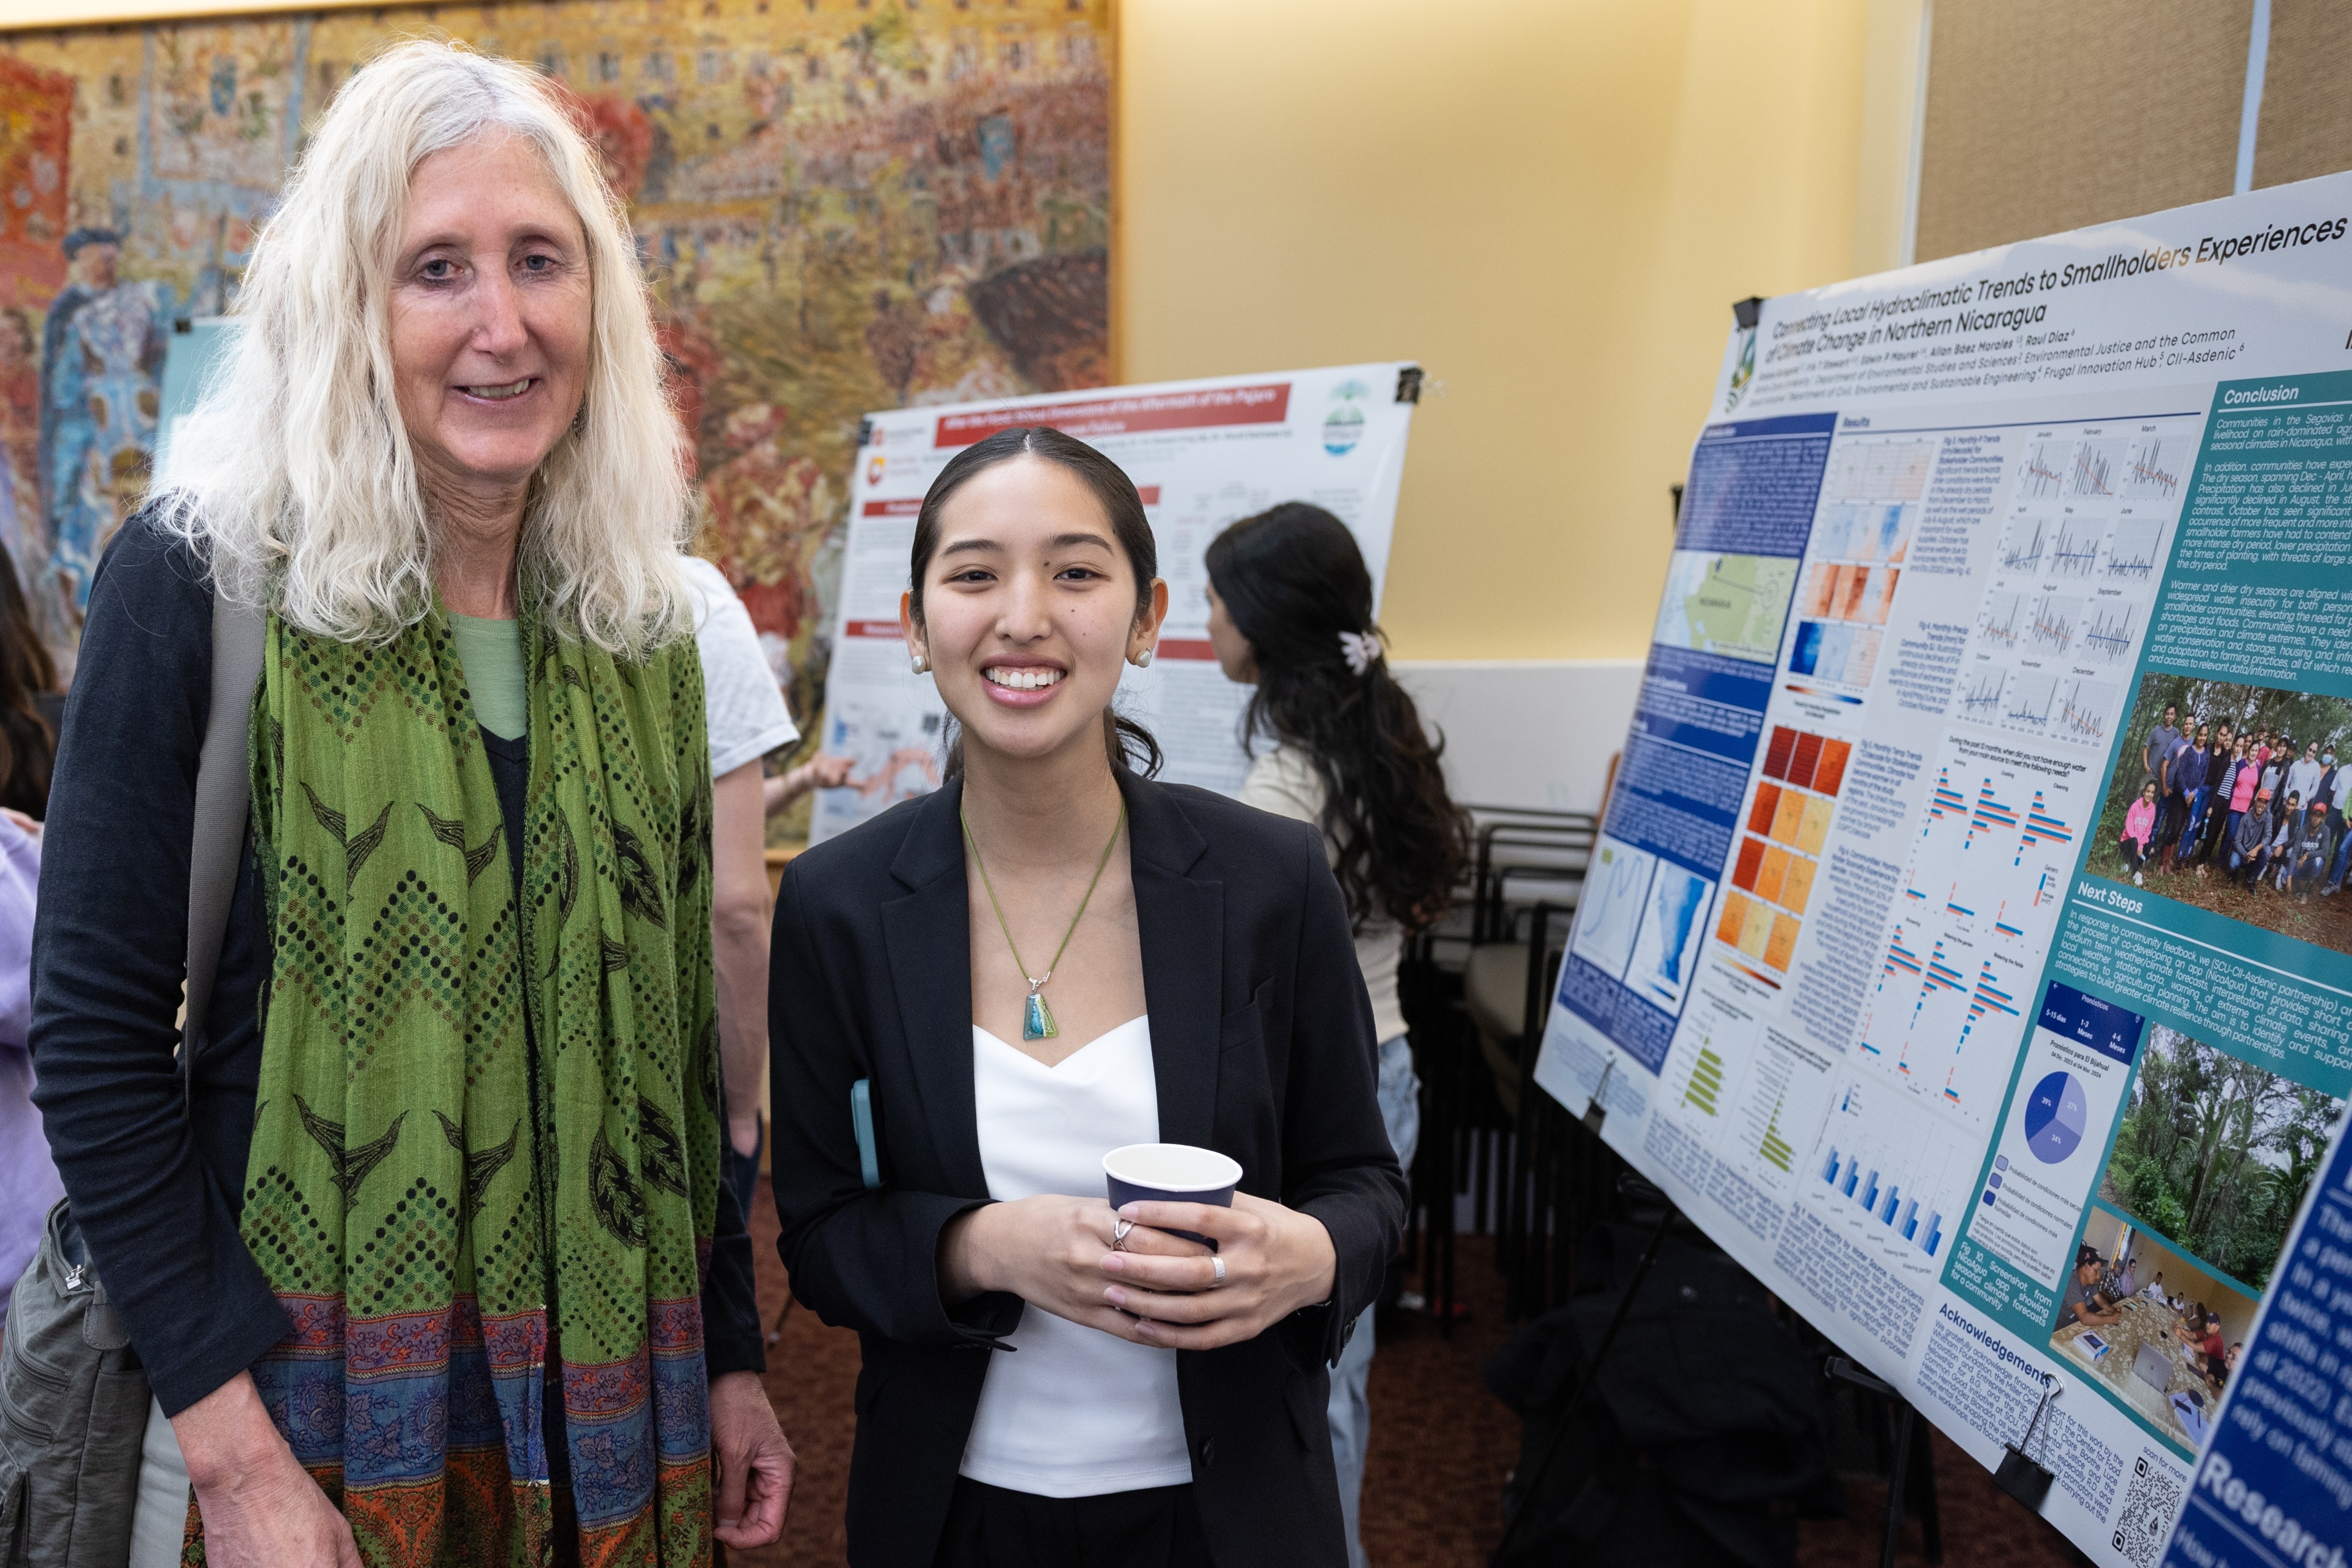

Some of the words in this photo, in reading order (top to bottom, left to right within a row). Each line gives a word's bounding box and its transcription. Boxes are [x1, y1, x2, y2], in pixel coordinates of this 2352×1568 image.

[1833, 302, 1869, 325] Local
[1870, 282, 1972, 316] Hydroclimatic
[1978, 271, 2034, 300] Trends
[2040, 270, 2057, 290] to
[2061, 247, 2191, 287] Smallholders
[2196, 218, 2347, 264] Experiences
[1817, 331, 1866, 352] Change
[1868, 326, 1881, 343] in
[1885, 318, 1951, 340] Northern
[1956, 305, 2046, 332] Nicaragua
[1930, 347, 1951, 356] Allan
[1978, 339, 2013, 351] Morales
[2026, 333, 2046, 345] Raul
[1959, 359, 1976, 370] and
[2024, 344, 2094, 363] Environmental
[2096, 341, 2131, 355] Justice
[2135, 336, 2156, 350] and
[2160, 335, 2177, 347] the
[2181, 329, 2235, 345] Common
[2044, 365, 2075, 379] Frugal
[2078, 359, 2131, 374] Innovation
[2167, 347, 2235, 365] CII-Asdenic
[2224, 385, 2299, 405] Conclusion
[2213, 428, 2250, 439] livelihood
[2267, 424, 2333, 437] rain-dominated
[2217, 417, 2268, 428] Communities
[2273, 416, 2281, 425] in
[2287, 415, 2300, 425] the
[2306, 412, 2343, 426] Segovias
[2210, 440, 2245, 450] seasonal
[2245, 439, 2279, 449] climates
[2280, 438, 2287, 447] in
[2288, 437, 2333, 448] Nicaragua,
[2202, 473, 2215, 482] The
[2216, 473, 2229, 485] dry
[2261, 472, 2299, 484] spanning
[2300, 471, 2317, 481] Dec
[2323, 470, 2345, 483] April,
[2195, 494, 2240, 506] significantly
[2243, 494, 2276, 504] declined
[2279, 494, 2287, 504] in
[2290, 494, 2320, 506] August,
[2325, 494, 2339, 504] the
[2171, 580, 2201, 590] Warmer
[2202, 583, 2219, 592] and
[2220, 583, 2238, 593] drier
[2240, 584, 2253, 597] dry
[2255, 588, 2287, 596] seasons
[2073, 666, 2095, 676] December
[2078, 882, 2104, 902] Next
[2107, 891, 2143, 914] Steps
[2067, 920, 2078, 930] the
[2079, 927, 2108, 942] process
[2122, 940, 2172, 967] co-developing
[2175, 960, 2185, 968] an
[2188, 965, 2203, 976] app
[2205, 969, 2247, 994] (NicaAgua)
[2250, 985, 2268, 1000] that
[2270, 993, 2309, 1014] provides
[2313, 1009, 2341, 1026] short
[2070, 909, 2077, 918] In
[2078, 914, 2109, 930] response
[2111, 923, 2119, 933] to
[2119, 928, 2161, 949] community
[2163, 941, 2196, 962] feedback,
[2200, 956, 2210, 965] we
[2210, 958, 2277, 990] (SCU-CII-Asdenic
[2278, 985, 2337, 1013] partnership)
[2077, 1027, 2093, 1039] Meses
[2081, 1019, 2089, 1027] 1-3
[2109, 1041, 2125, 1054] Meses
[2112, 1033, 2121, 1042] 4-6
[2050, 1040, 2073, 1055] Pronóstico
[2074, 1052, 2084, 1060] para
[2090, 1058, 2109, 1071] Bijahual
[2042, 1097, 2051, 1107] 39%
[1957, 1251, 1987, 1277] NicaAgua
[1996, 1278, 2009, 1292] app
[2018, 1293, 2049, 1318] showing
[1960, 1241, 1971, 1255] Fig
[1989, 1261, 2027, 1291] Screenshot
[2034, 1289, 2051, 1307] from
[1954, 1261, 1982, 1284] seasonal
[1984, 1282, 2009, 1302] climate
[2013, 1299, 2045, 1326] forecasts
[1939, 1303, 2051, 1389] Acknowledgements
[1936, 1320, 1944, 1331] We
[1945, 1329, 1972, 1352] gratefully
[1973, 1349, 2012, 1382] acknowledge
[2014, 1376, 2041, 1400] financial
[2067, 1415, 2076, 1426] for
[2078, 1423, 2088, 1437] this
[2089, 1434, 2103, 1450] work
[2104, 1445, 2112, 1460] by
[2113, 1454, 2123, 1467] the
[2143, 1446, 2158, 1462] scan
[2159, 1457, 2169, 1468] for
[2169, 1466, 2187, 1483] more
